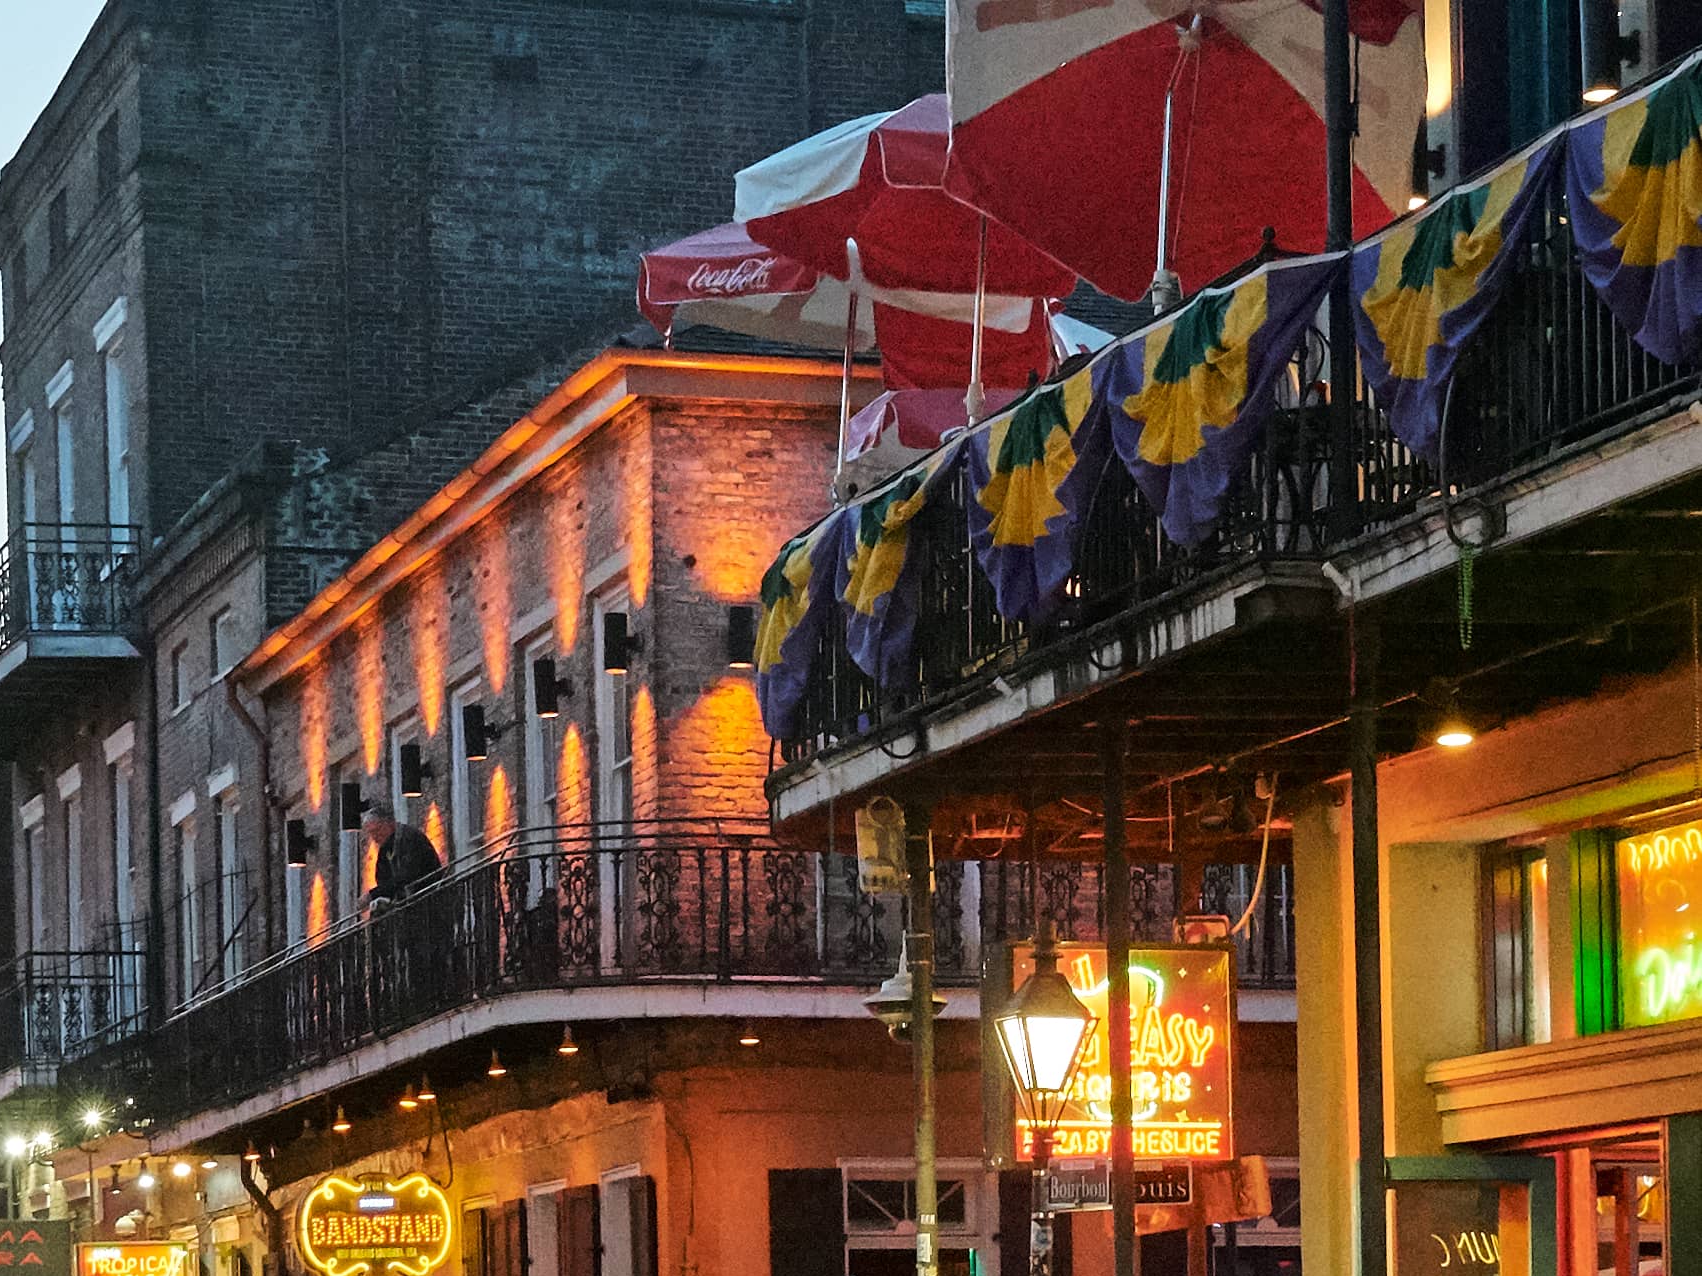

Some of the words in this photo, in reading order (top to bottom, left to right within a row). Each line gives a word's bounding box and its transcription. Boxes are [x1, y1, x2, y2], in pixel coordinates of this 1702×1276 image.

[1132, 1131, 1160, 1153] HE
[1161, 1130, 1220, 1154] SLICE
[1050, 1176, 1108, 1198] Bourbon
[311, 1214, 444, 1245] BANDSTAND
